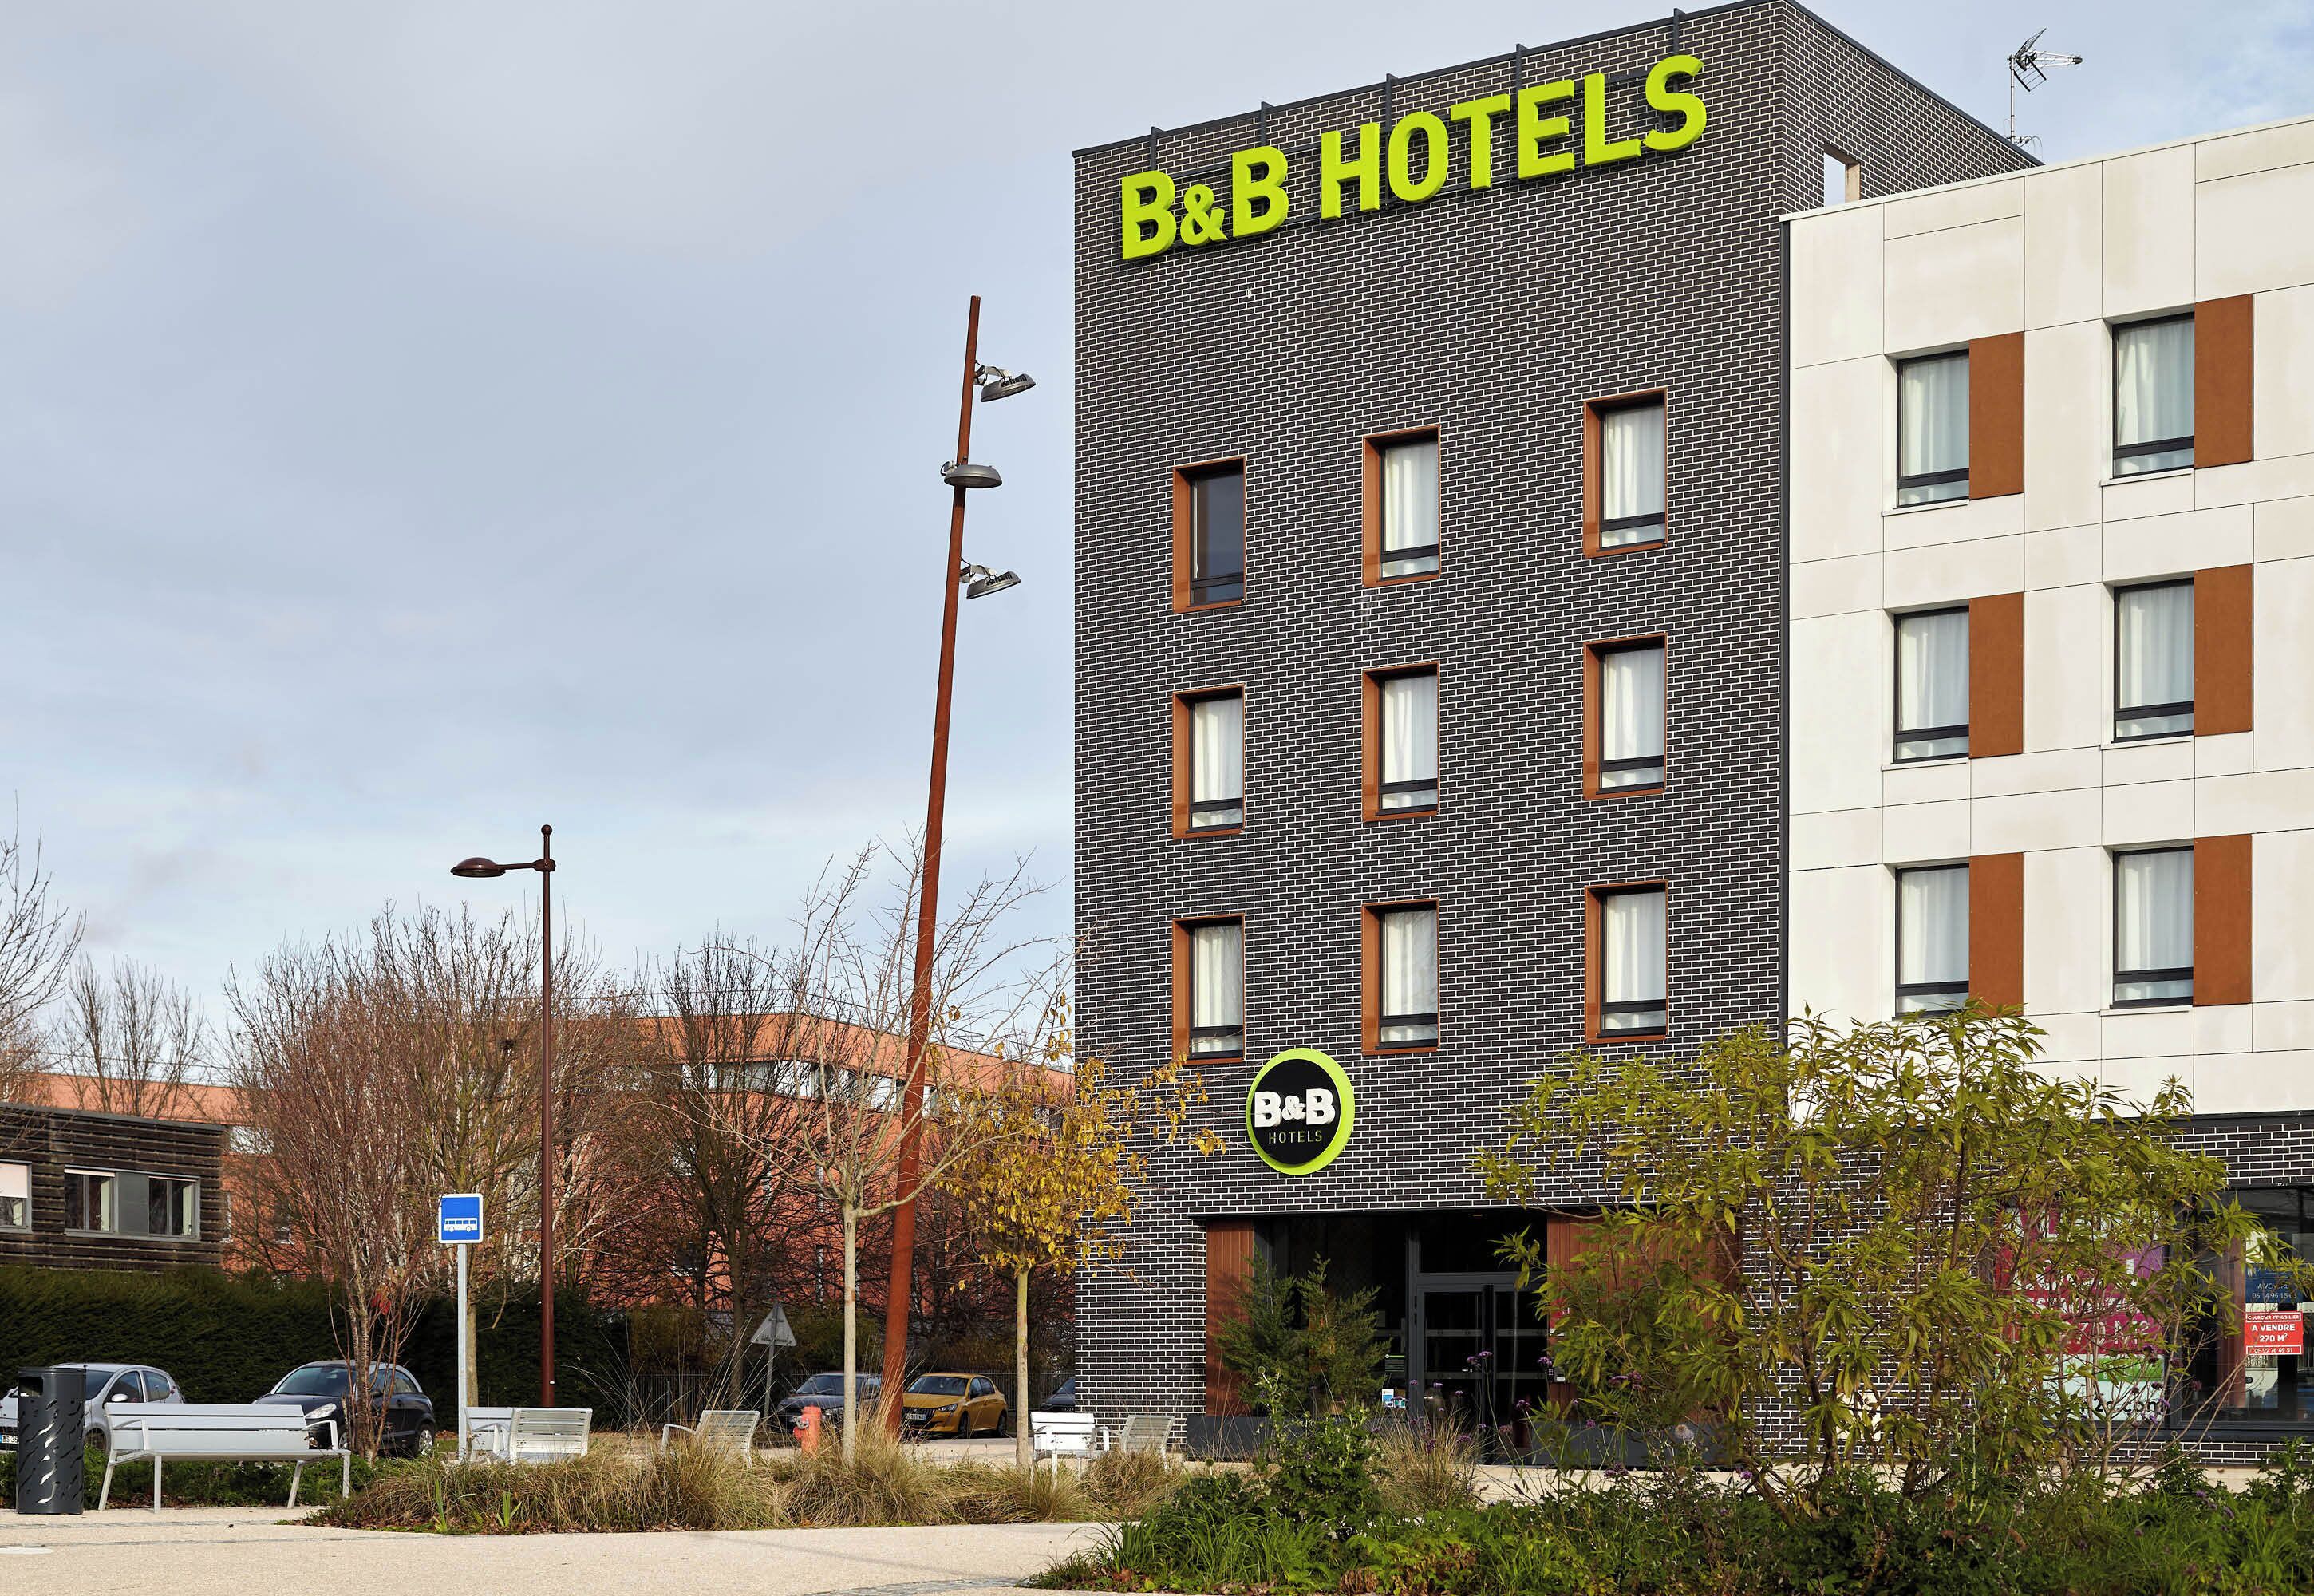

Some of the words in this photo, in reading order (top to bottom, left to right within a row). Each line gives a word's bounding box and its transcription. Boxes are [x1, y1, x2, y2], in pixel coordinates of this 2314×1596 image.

[1121, 147, 1289, 260] B&B
[1321, 54, 1708, 219] HOTELS
[1254, 1088, 1336, 1128] B&B
[1268, 1130, 1323, 1144] HOTELS
